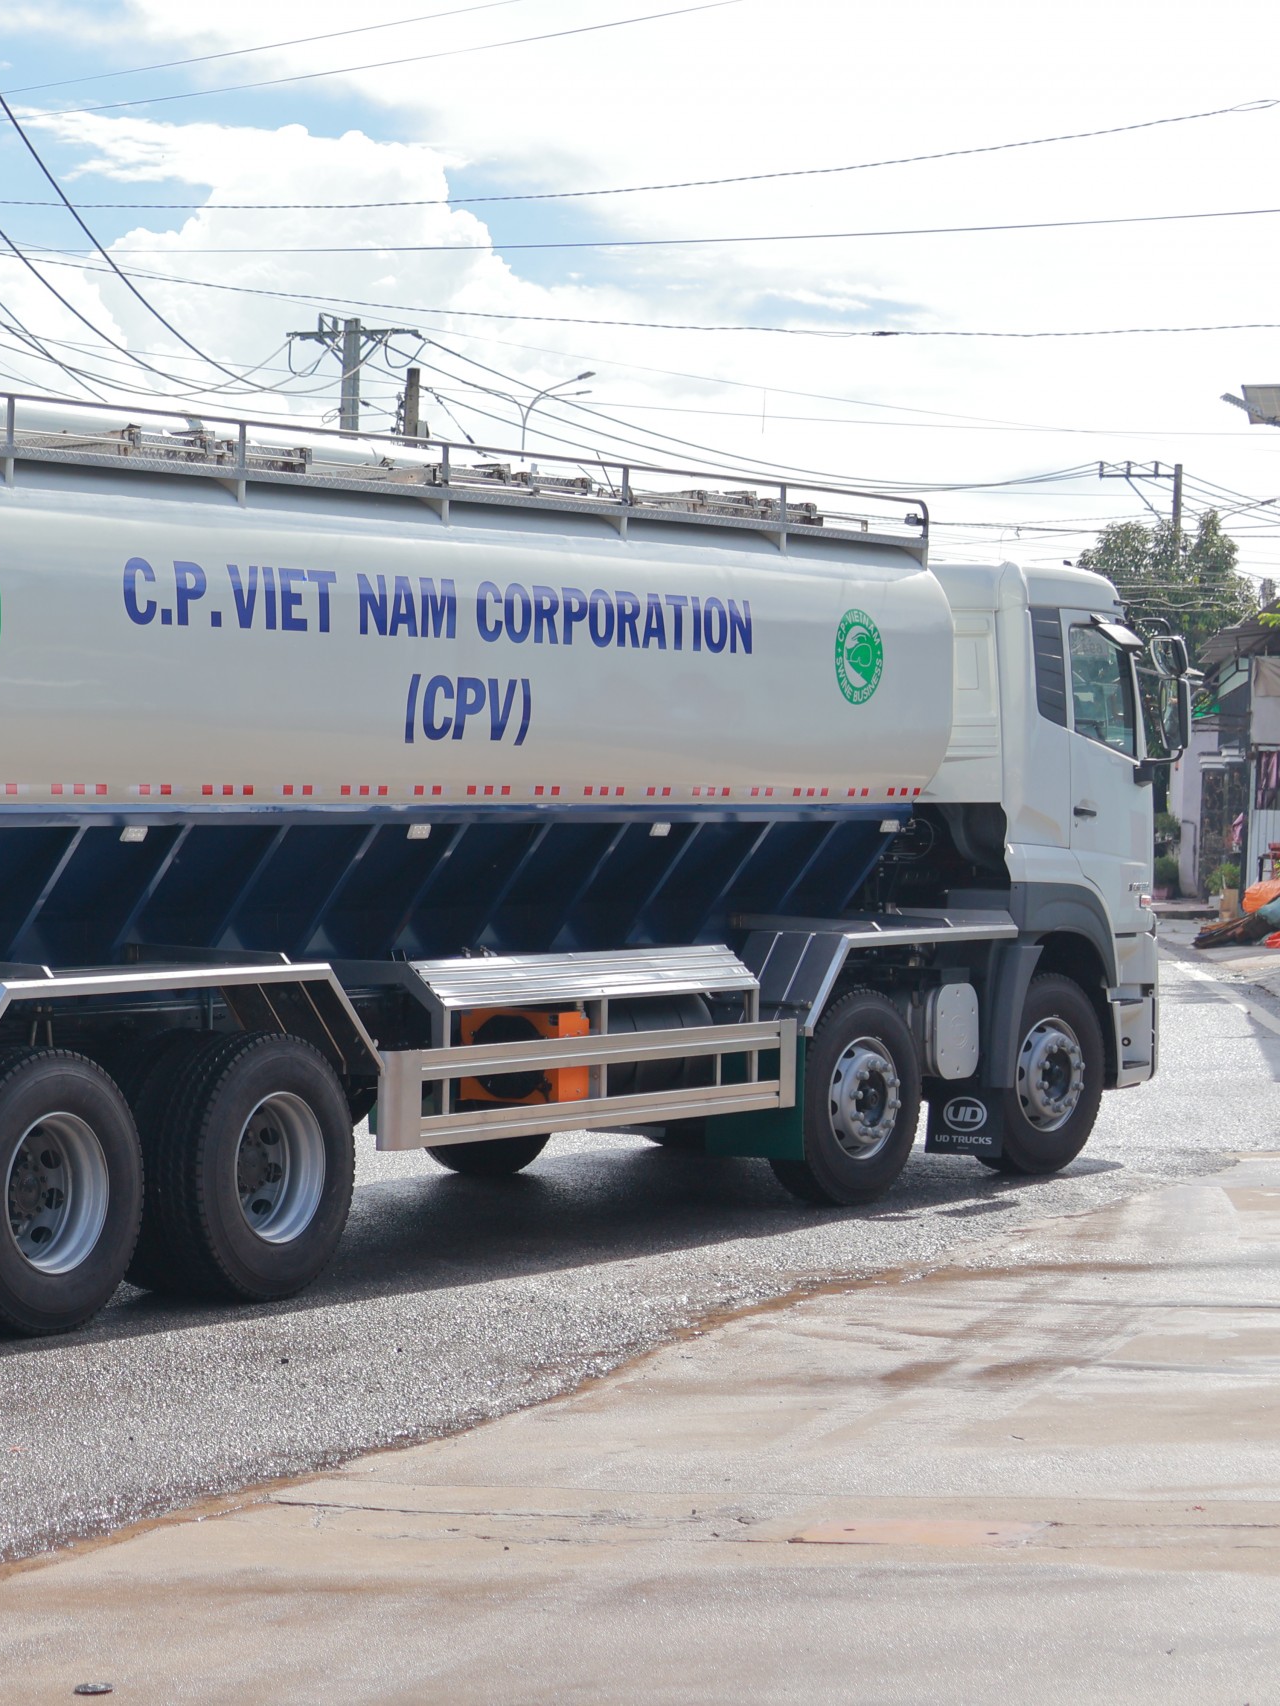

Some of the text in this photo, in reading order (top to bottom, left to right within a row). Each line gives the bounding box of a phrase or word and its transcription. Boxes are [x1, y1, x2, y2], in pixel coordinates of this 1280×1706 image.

[357, 573, 457, 639] NAM
[476, 580, 753, 655] CORPORATION
[836, 656, 882, 703] SWINE BUSINESS
[405, 673, 532, 746] (CPV)
[947, 1105, 984, 1123] UD
[935, 1134, 992, 1145] UD TRUCKS
